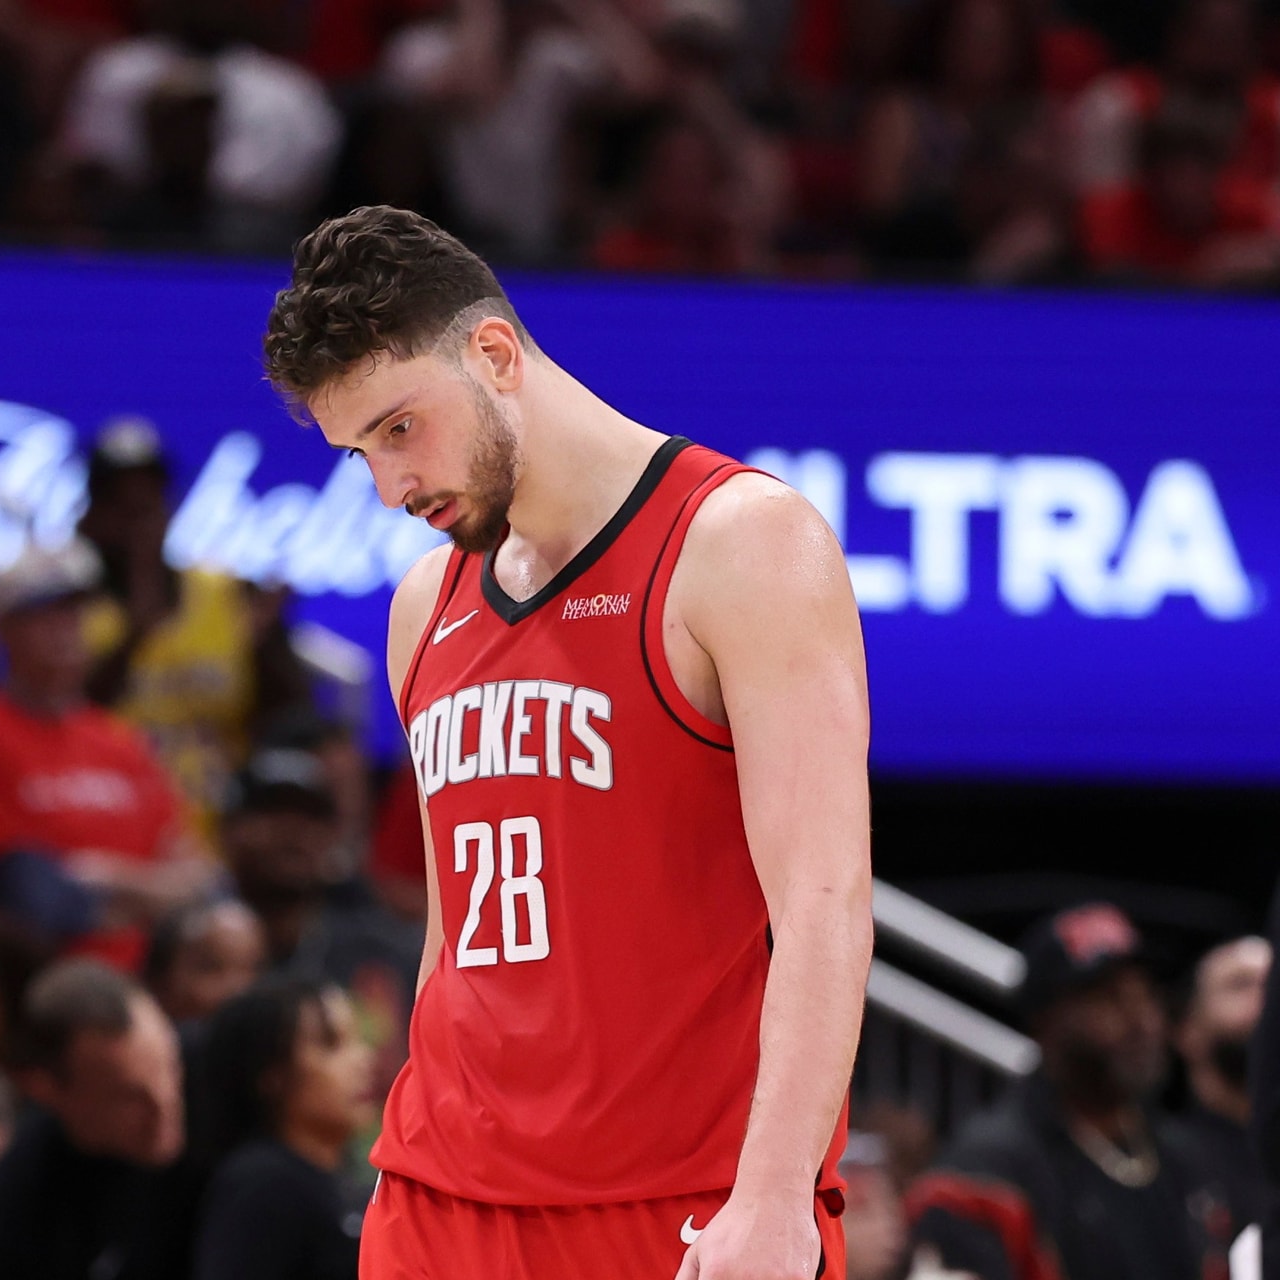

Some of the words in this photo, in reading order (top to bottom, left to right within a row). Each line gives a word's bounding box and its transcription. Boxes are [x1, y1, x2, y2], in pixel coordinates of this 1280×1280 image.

[742, 447, 1254, 621] LTRA
[561, 601, 630, 620] HERMANN
[564, 592, 631, 610] MEMORIAL
[453, 815, 551, 969] 28
